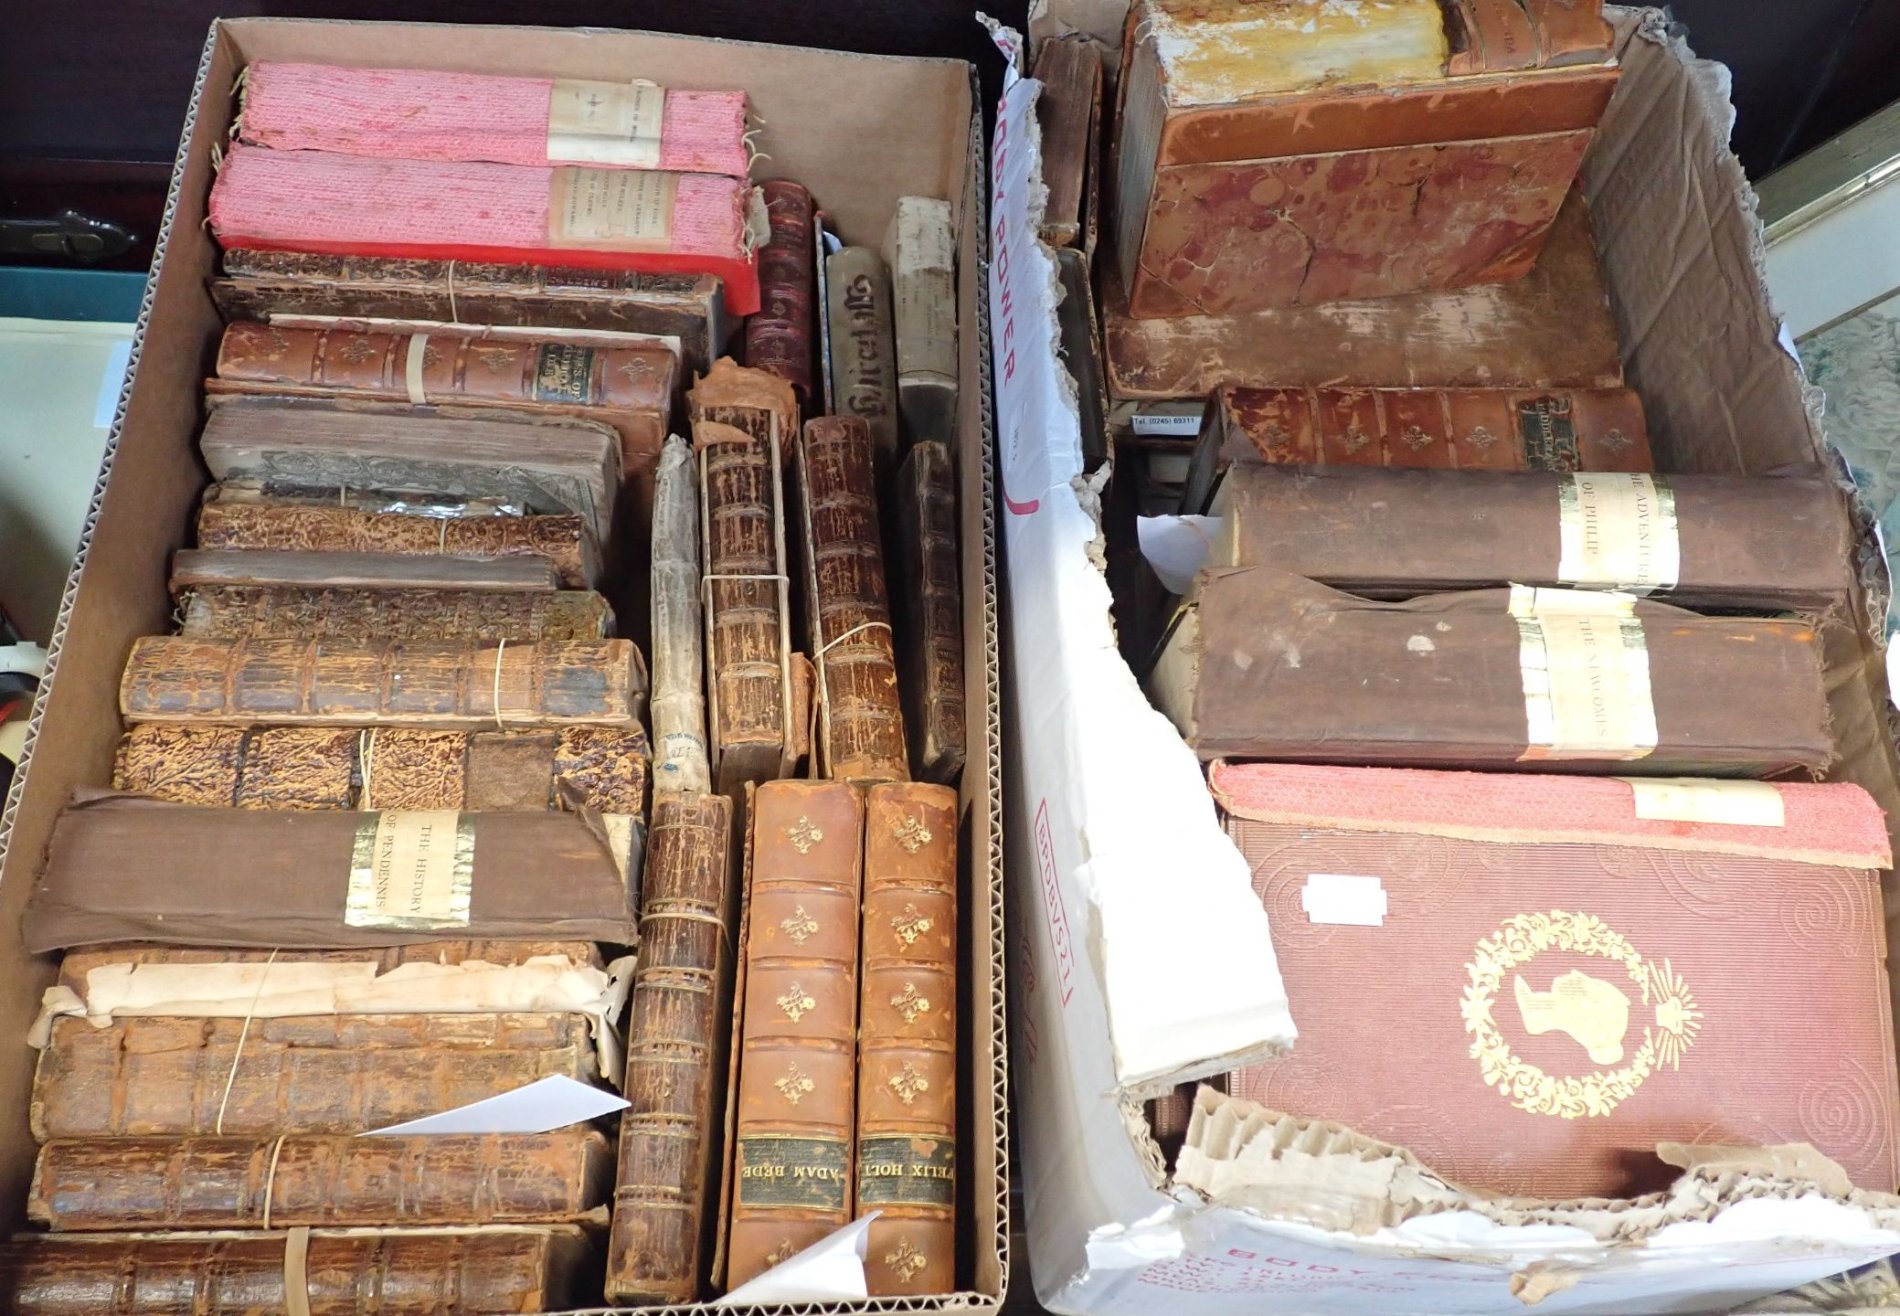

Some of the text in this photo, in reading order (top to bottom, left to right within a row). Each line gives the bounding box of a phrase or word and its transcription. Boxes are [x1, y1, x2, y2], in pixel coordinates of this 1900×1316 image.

[994, 214, 1015, 388] POWER
[1581, 481, 1599, 556] OF PHILIP
[1630, 472, 1650, 586] HE ADVENTURE
[1578, 616, 1608, 738] THE NEWCOMES
[375, 813, 397, 908] OF PENDENNIS
[410, 824, 433, 914] THE HISTORY
[741, 1164, 840, 1182] ADAM BEDE
[911, 1164, 954, 1180] FELIX
[1227, 1247, 1378, 1275] BODY
